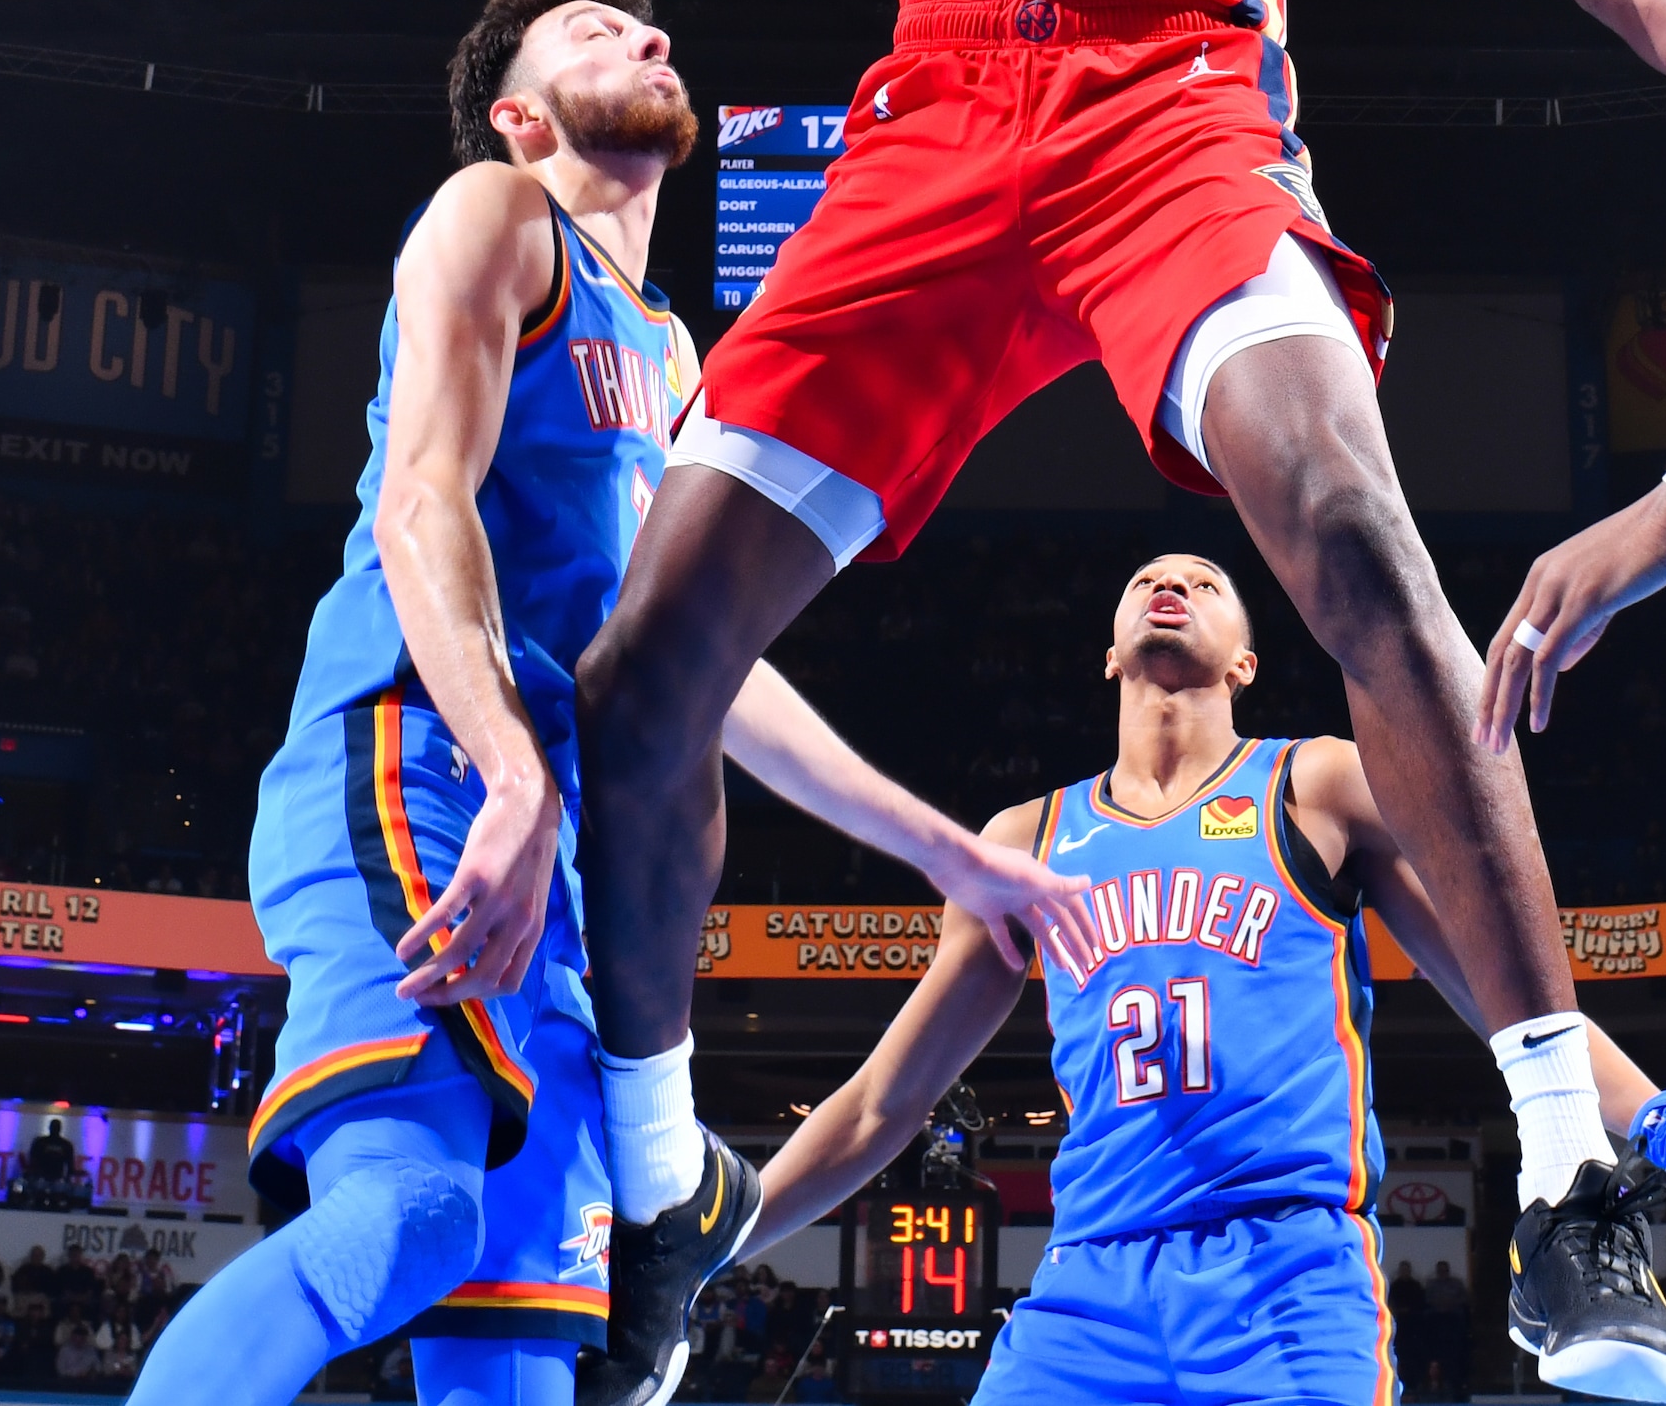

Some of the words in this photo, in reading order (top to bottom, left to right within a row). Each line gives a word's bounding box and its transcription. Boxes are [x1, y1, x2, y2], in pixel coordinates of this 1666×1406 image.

[718, 106, 783, 150] OKC
[802, 115, 845, 149] 17
[720, 158, 755, 170] PLAYER
[720, 177, 827, 191] GILGEOUS-ALEXAN
[720, 200, 758, 211] DORT
[718, 222, 796, 234] HOLMGREN
[718, 243, 775, 256] CARUSO
[718, 265, 774, 277] WIGGIN
[723, 290, 741, 306] TO
[89, 287, 237, 416] CITY
[569, 339, 672, 451] THUN
[0, 434, 86, 467] EXIT
[100, 446, 192, 478] NOW
[65, 895, 100, 921] 12
[1580, 909, 1660, 929] WORRY
[1591, 956, 1647, 974] TOUR
[1107, 976, 1213, 1107] 21
[890, 1205, 975, 1245] 3:41
[63, 1222, 118, 1254] POST
[151, 1229, 197, 1259] OAK
[901, 1246, 965, 1315] 14
[889, 1329, 981, 1350] TISSOT
